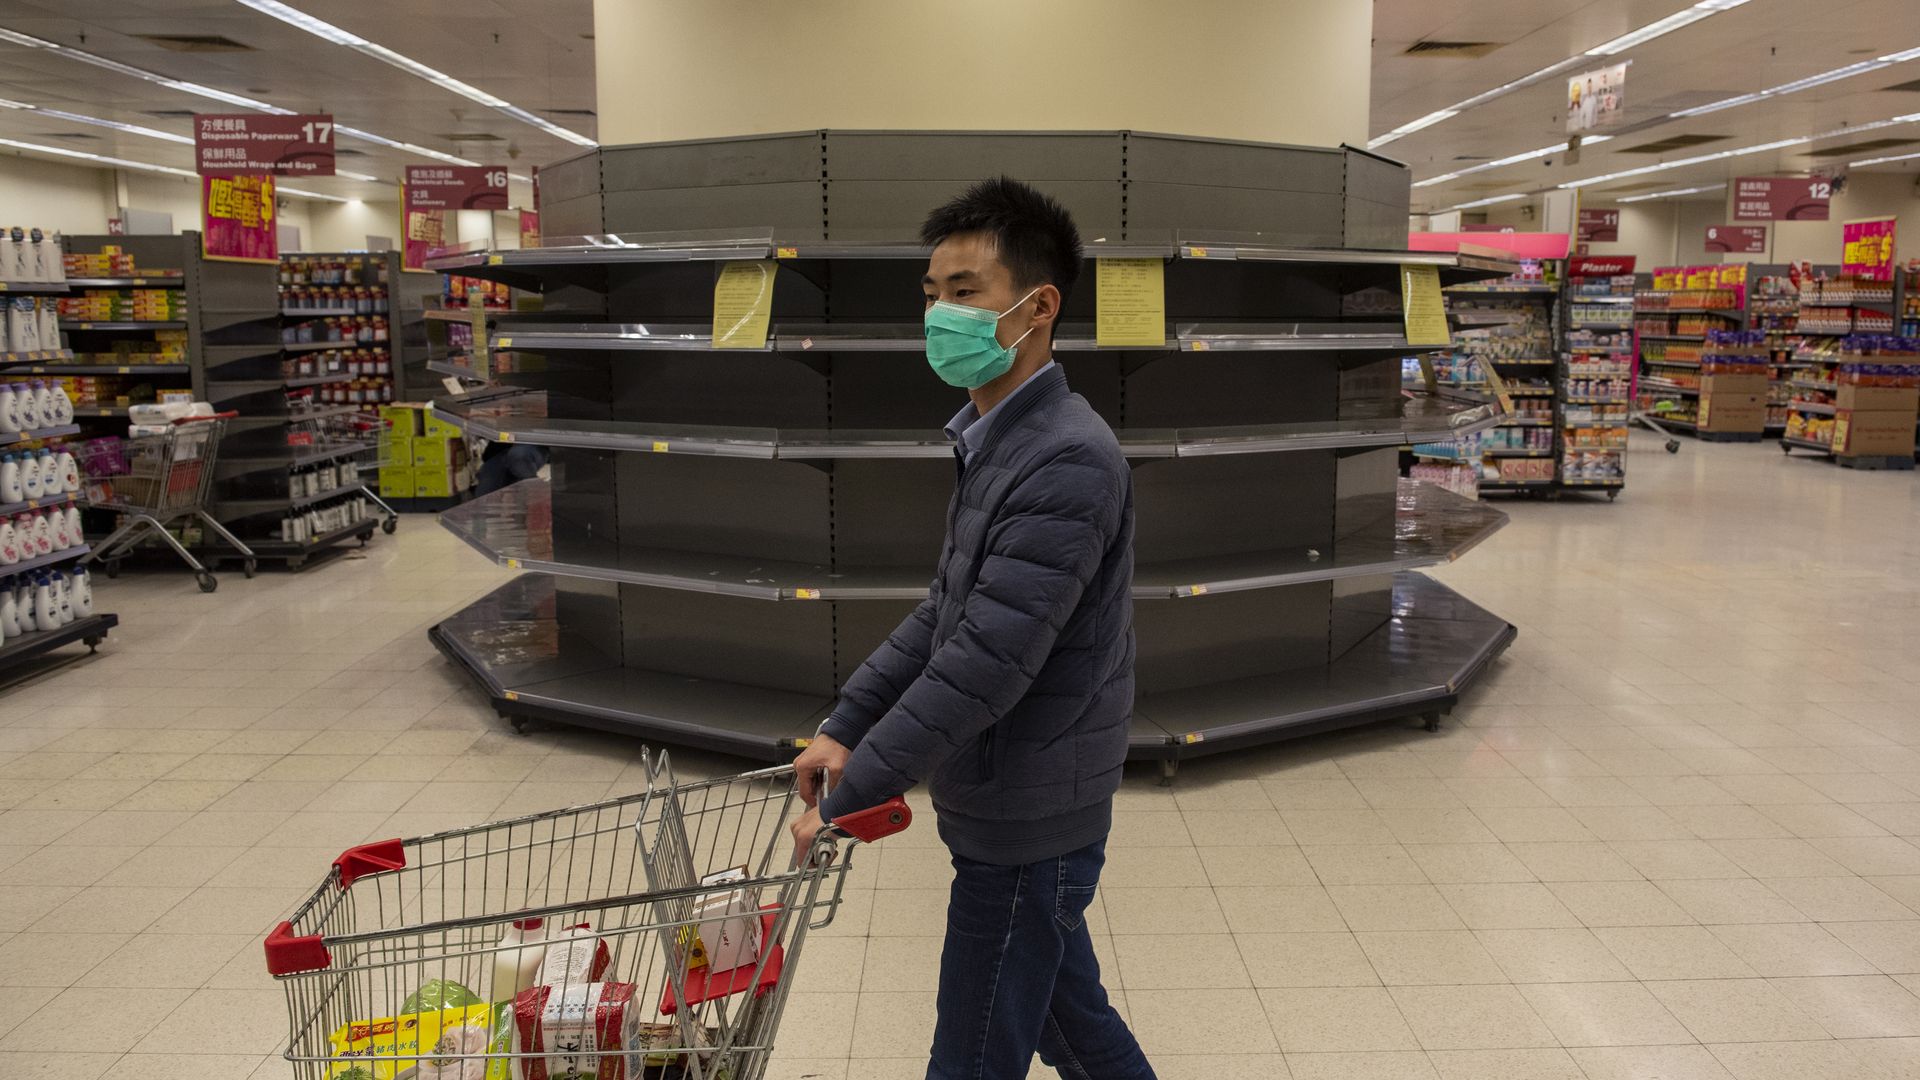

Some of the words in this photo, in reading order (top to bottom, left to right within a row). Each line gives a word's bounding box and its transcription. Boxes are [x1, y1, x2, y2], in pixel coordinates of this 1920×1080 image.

[201, 119, 247, 132] 方便餐具
[201, 132, 249, 140] Disposable
[251, 132, 299, 140] Paperware
[302, 122, 332, 143] 17
[202, 147, 247, 160] 保鮮用品
[202, 161, 247, 169] Household
[248, 161, 275, 169] Wraps
[277, 161, 293, 169] and
[295, 161, 317, 170] Bags
[485, 171, 507, 187] 16
[412, 190, 429, 199] 文具
[1808, 183, 1830, 198] 12
[1603, 214, 1617, 226] 11
[109, 222, 122, 233] 14
[1707, 228, 1718, 240] 6
[1580, 263, 1622, 273] Plaster
